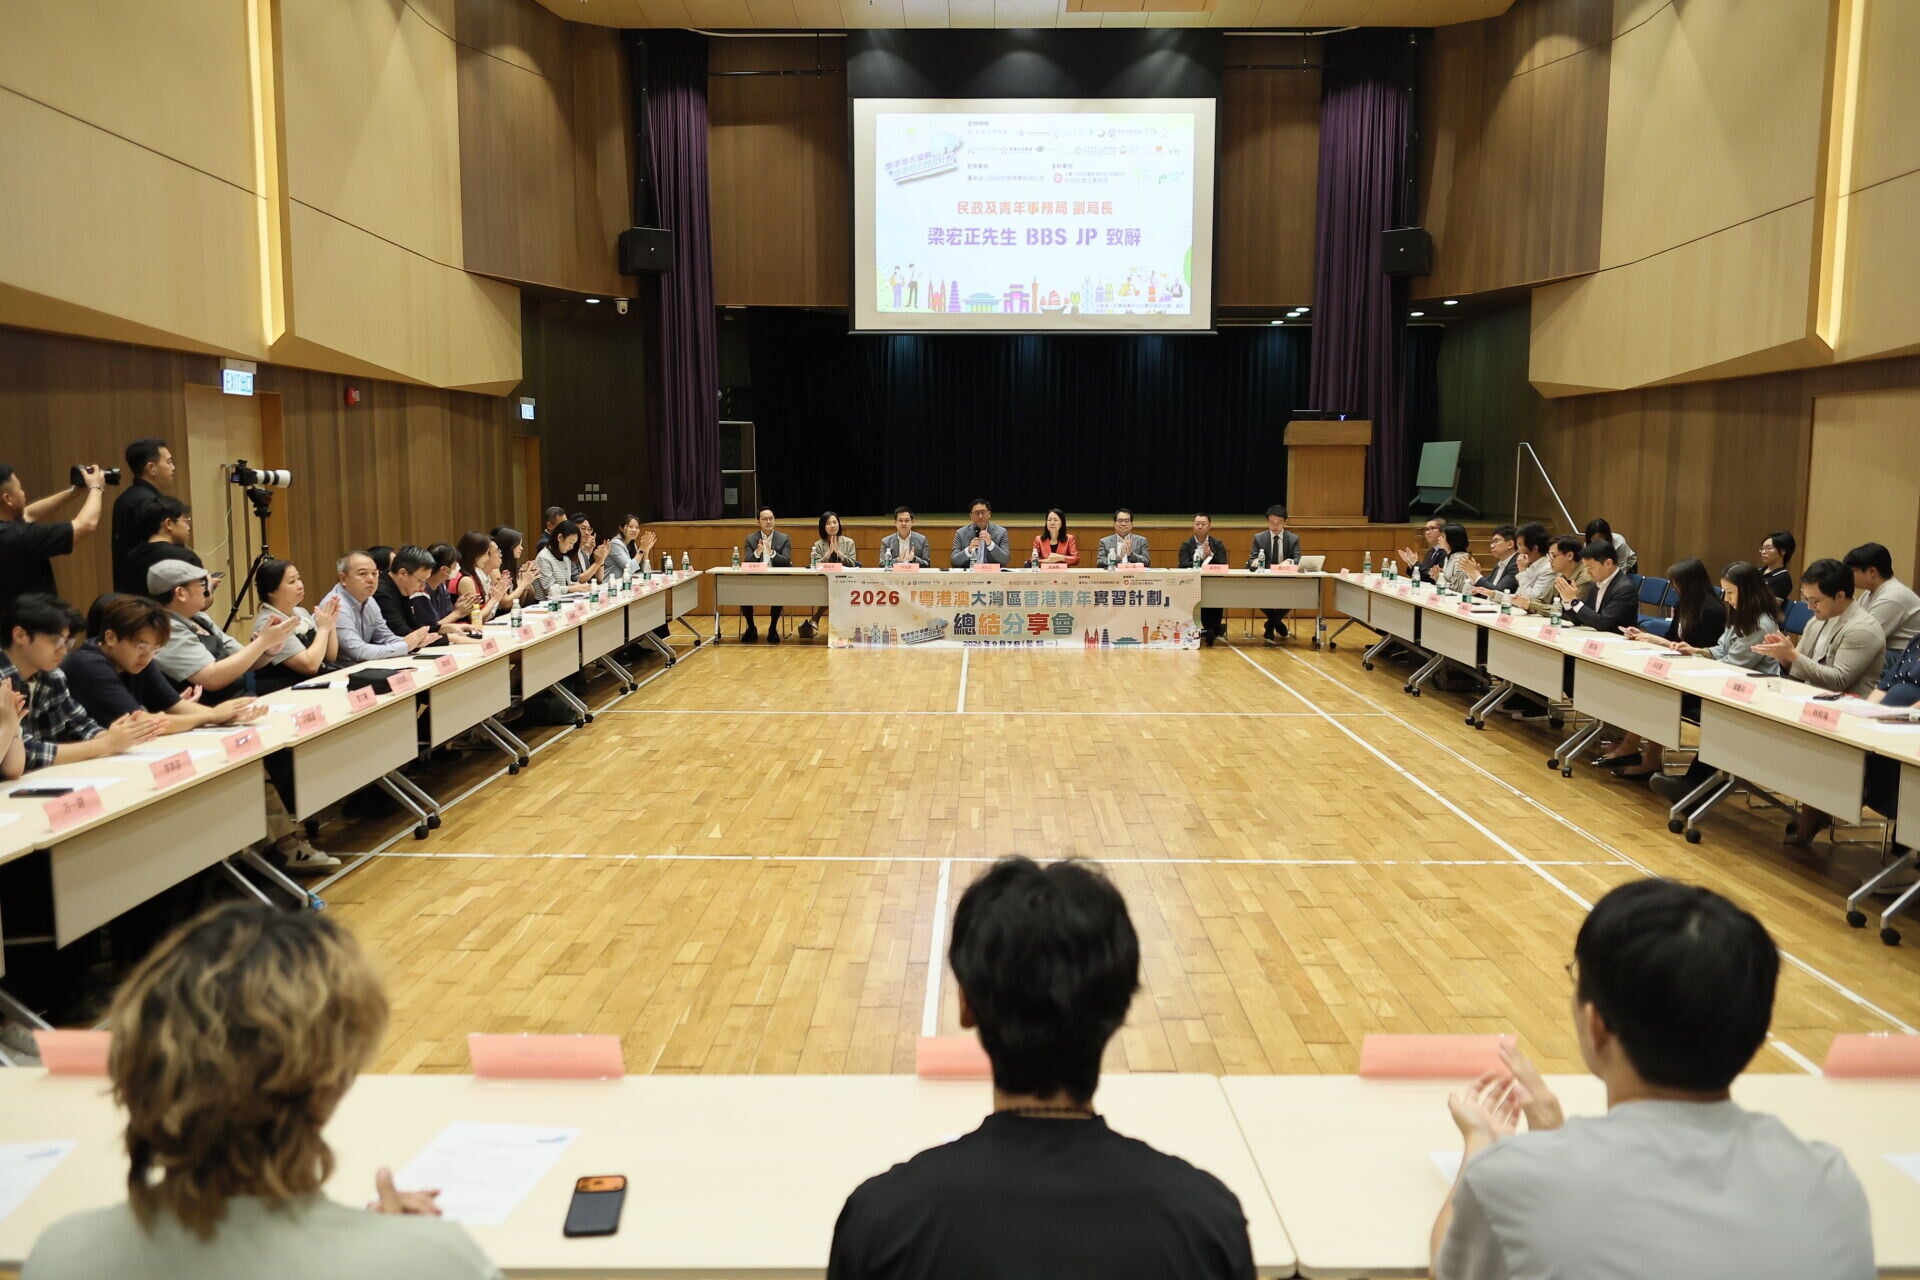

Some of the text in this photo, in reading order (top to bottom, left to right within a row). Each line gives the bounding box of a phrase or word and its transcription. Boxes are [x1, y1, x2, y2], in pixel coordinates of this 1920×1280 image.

[957, 201, 1113, 215] 民政及青年事務局 副局長
[928, 227, 1141, 246] 梁宏正先生 BBS JP 致辭
[850, 590, 900, 605] 2026
[954, 612, 1075, 636] 總結分享會
